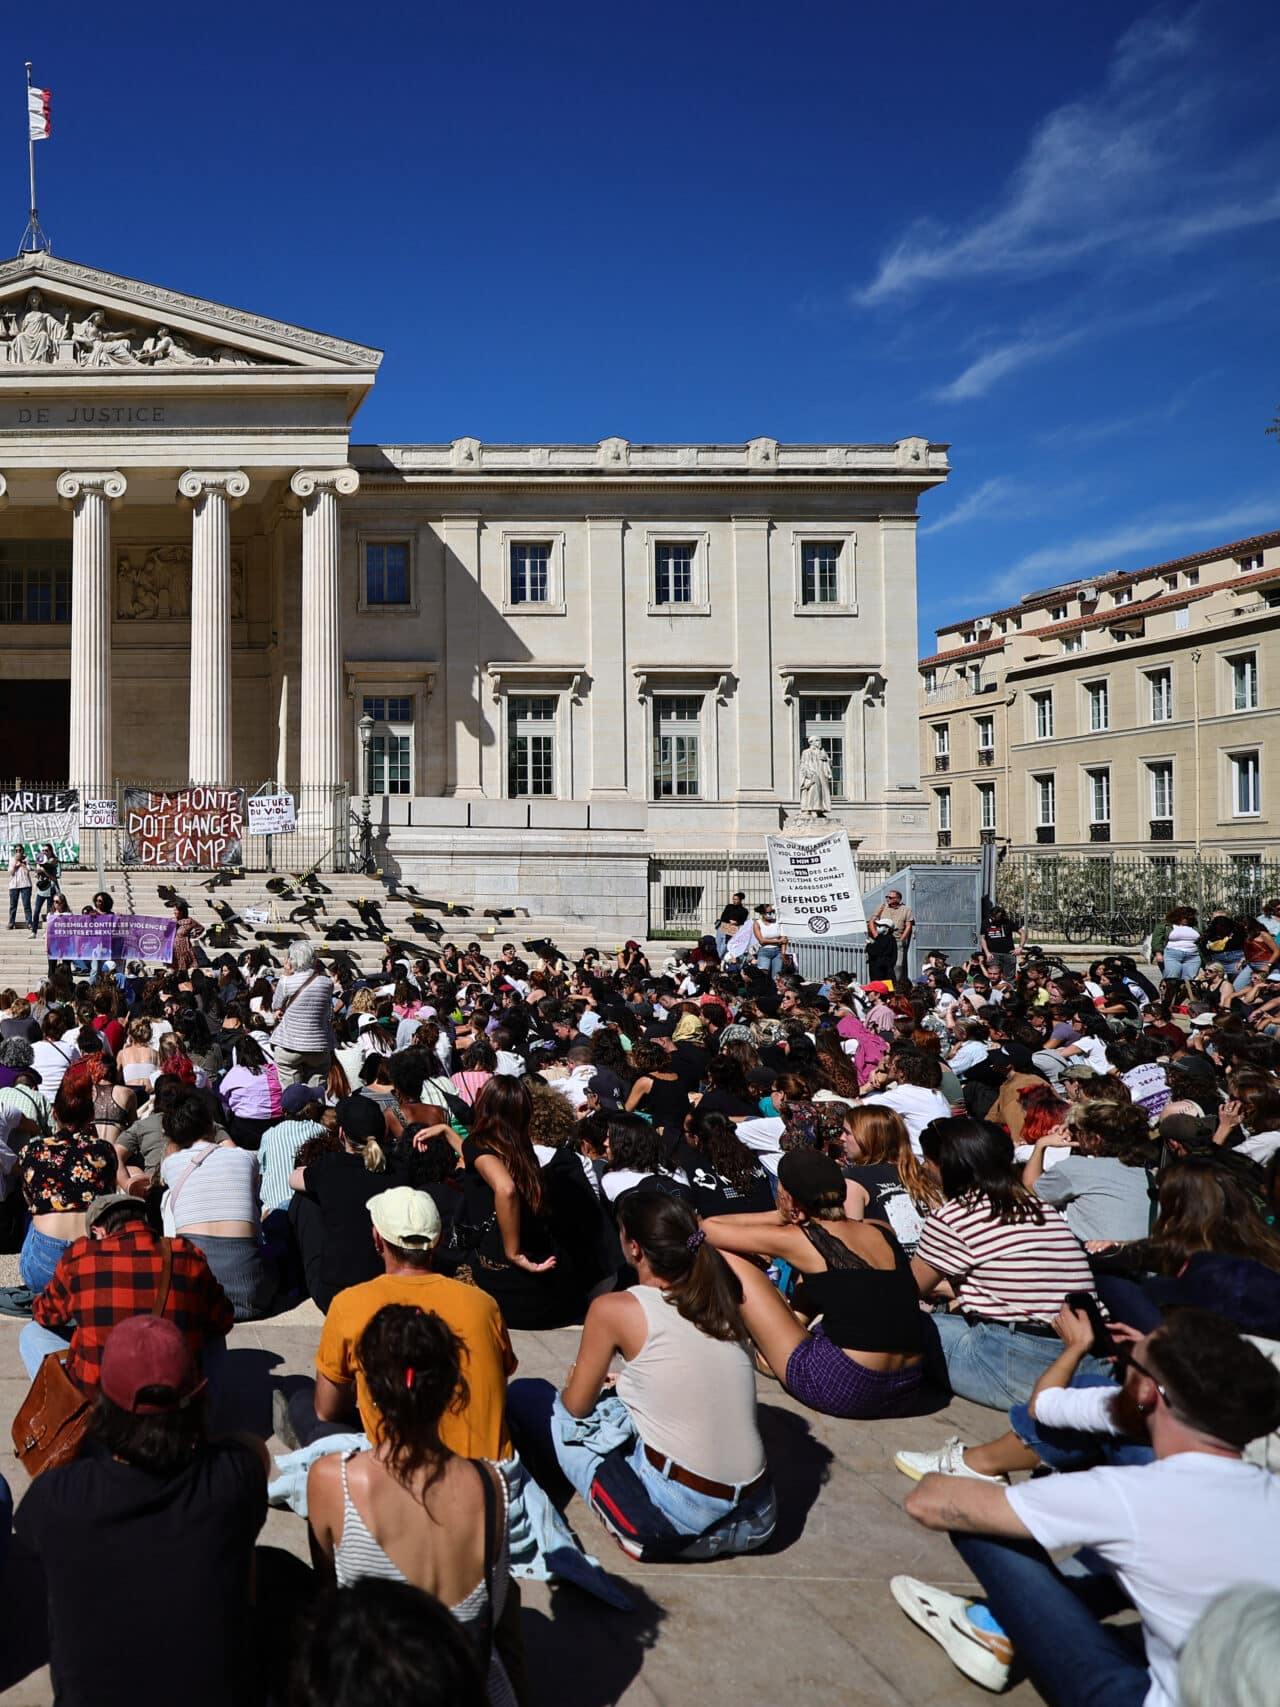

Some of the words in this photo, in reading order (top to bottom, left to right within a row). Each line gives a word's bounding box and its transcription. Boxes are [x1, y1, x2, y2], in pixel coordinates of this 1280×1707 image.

[18, 408, 49, 423] DE
[66, 407, 165, 422] JUSTICE
[148, 792, 171, 813] LA
[177, 788, 238, 812] HONTE
[249, 798, 291, 807] CULTURE
[174, 812, 242, 839] CHANGER
[142, 841, 167, 864] DE
[176, 838, 225, 869] CAMP
[780, 894, 828, 904] DÉFENDS
[830, 892, 850, 901] TES
[794, 905, 838, 914] SOEURS
[130, 922, 167, 931] VIOLENCES
